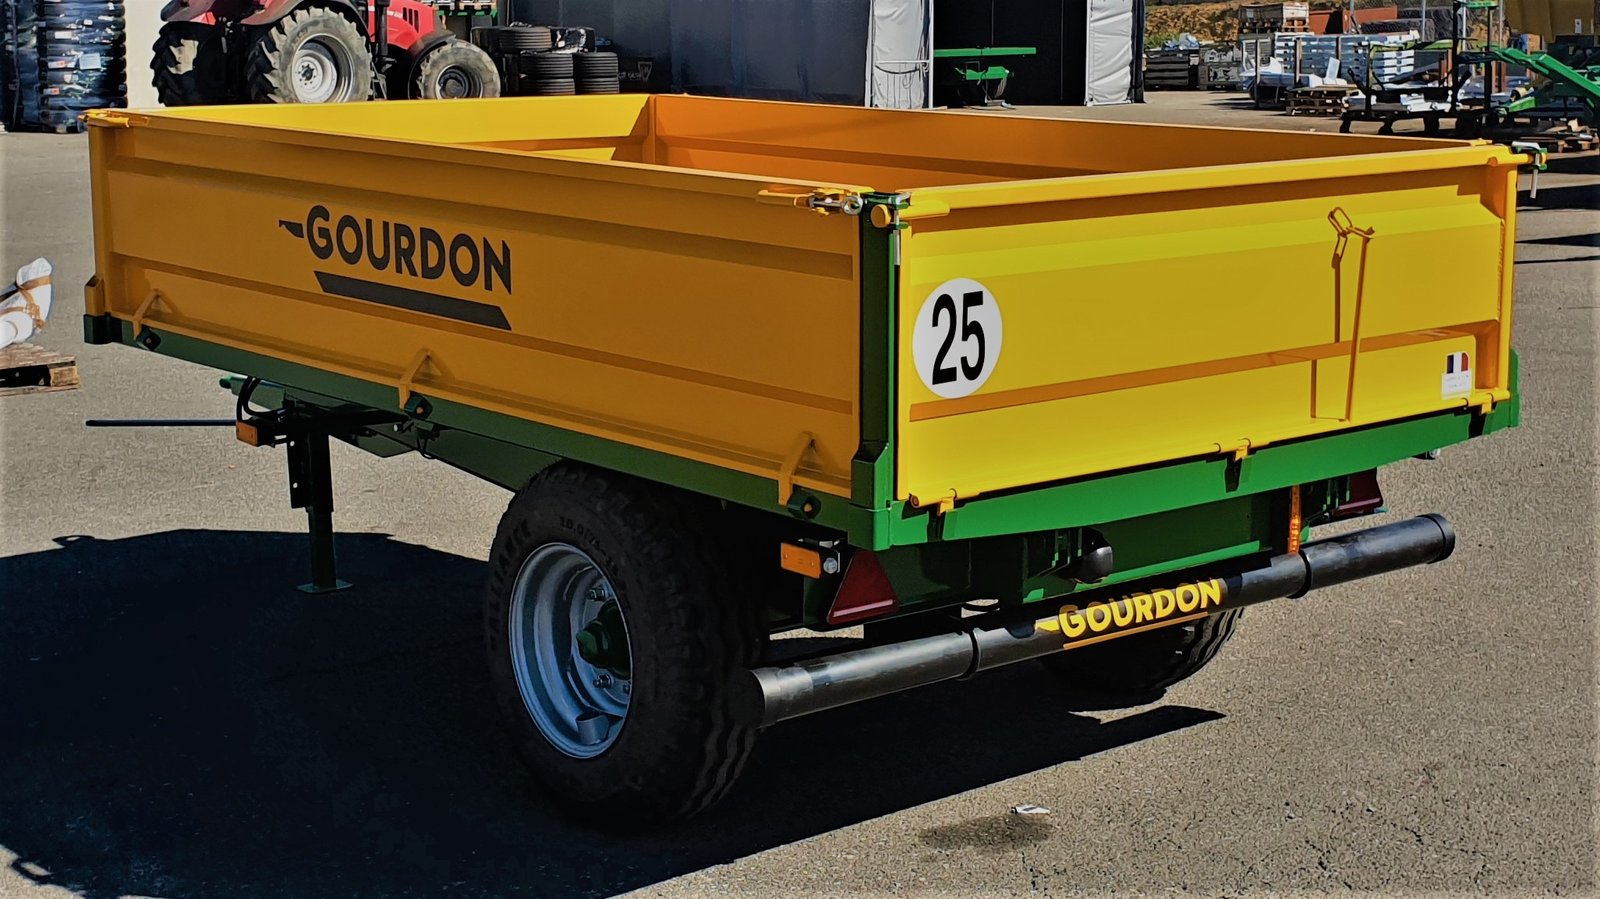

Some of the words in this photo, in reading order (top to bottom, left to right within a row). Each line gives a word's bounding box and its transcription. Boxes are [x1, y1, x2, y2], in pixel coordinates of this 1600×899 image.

[306, 205, 512, 295] GOURDON
[932, 291, 985, 385] 25
[1058, 577, 1222, 638] GOURDON
